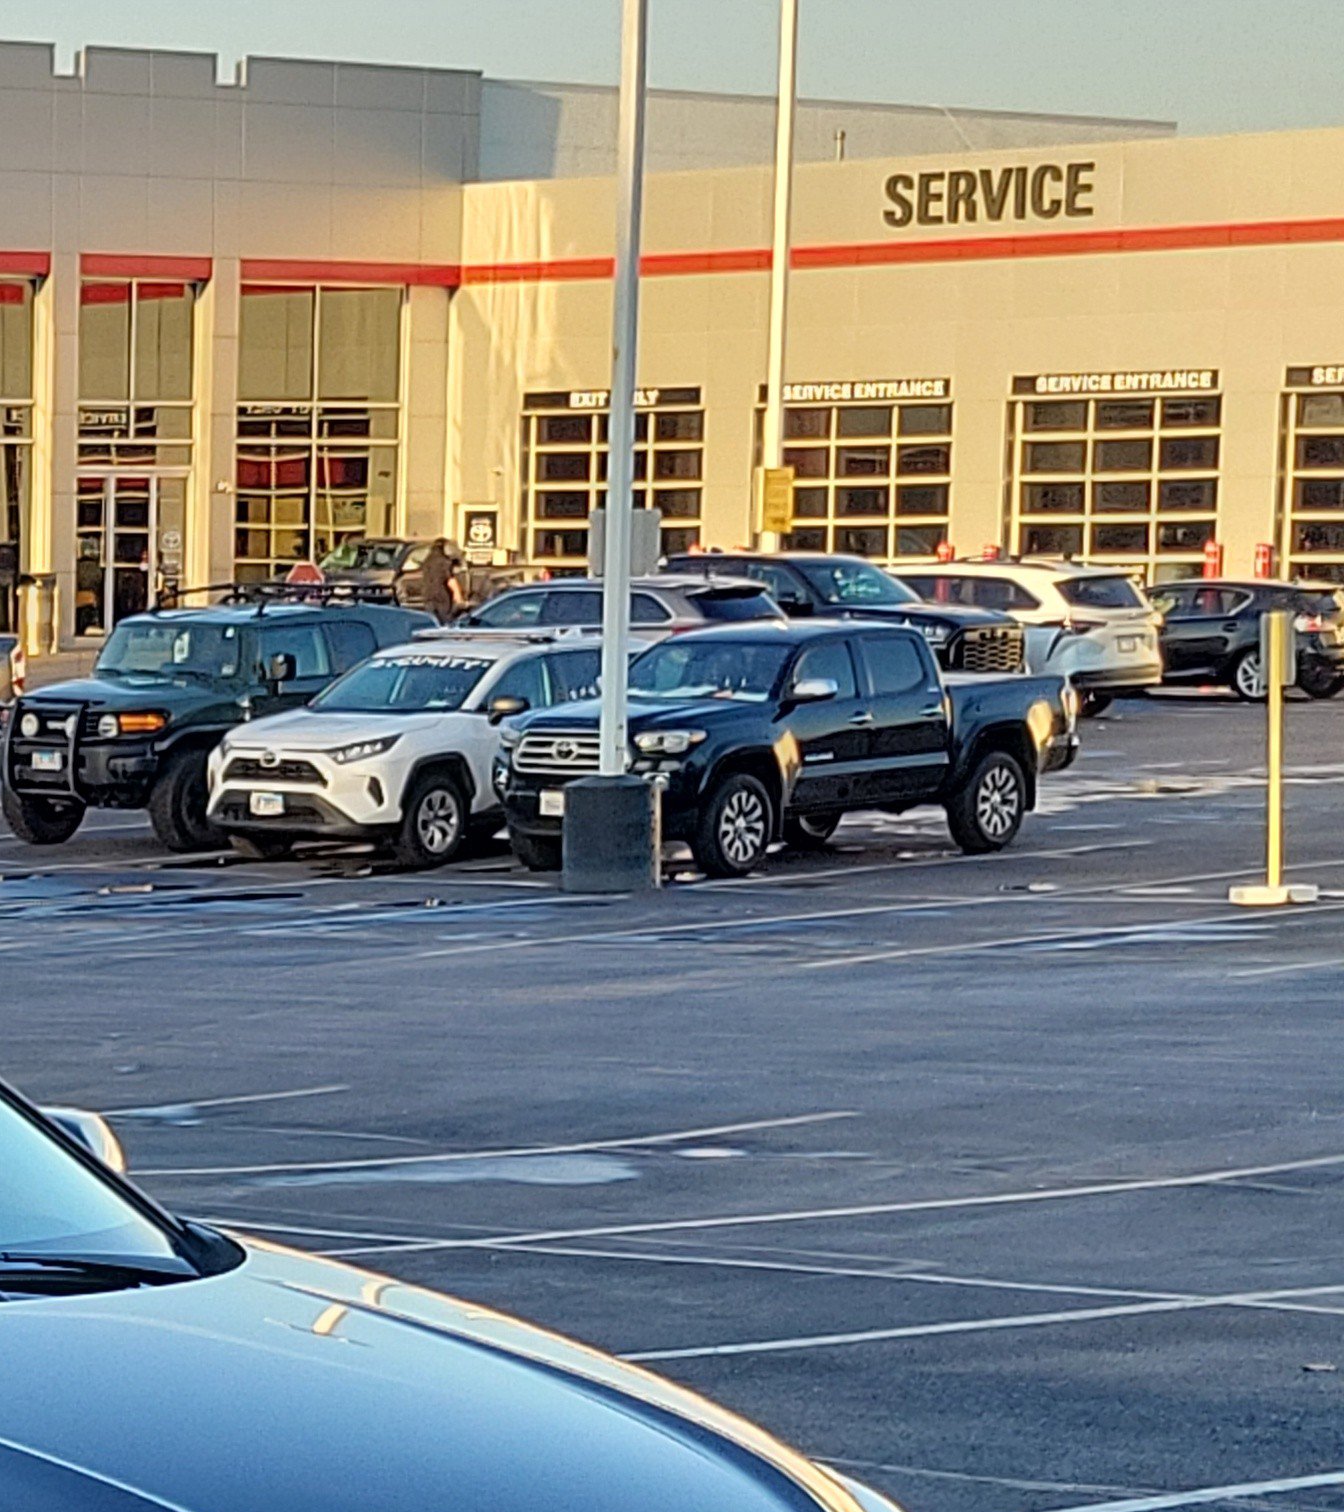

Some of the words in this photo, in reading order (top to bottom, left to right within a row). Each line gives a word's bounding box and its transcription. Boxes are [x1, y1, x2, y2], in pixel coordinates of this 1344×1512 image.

[883, 161, 1095, 228] SERVICE
[783, 382, 852, 401] SERVICE
[854, 380, 945, 399] ENTRANCE
[1035, 374, 1111, 394] SERVICE
[1113, 371, 1213, 391] ENTRANCE
[569, 390, 609, 408] EXIT
